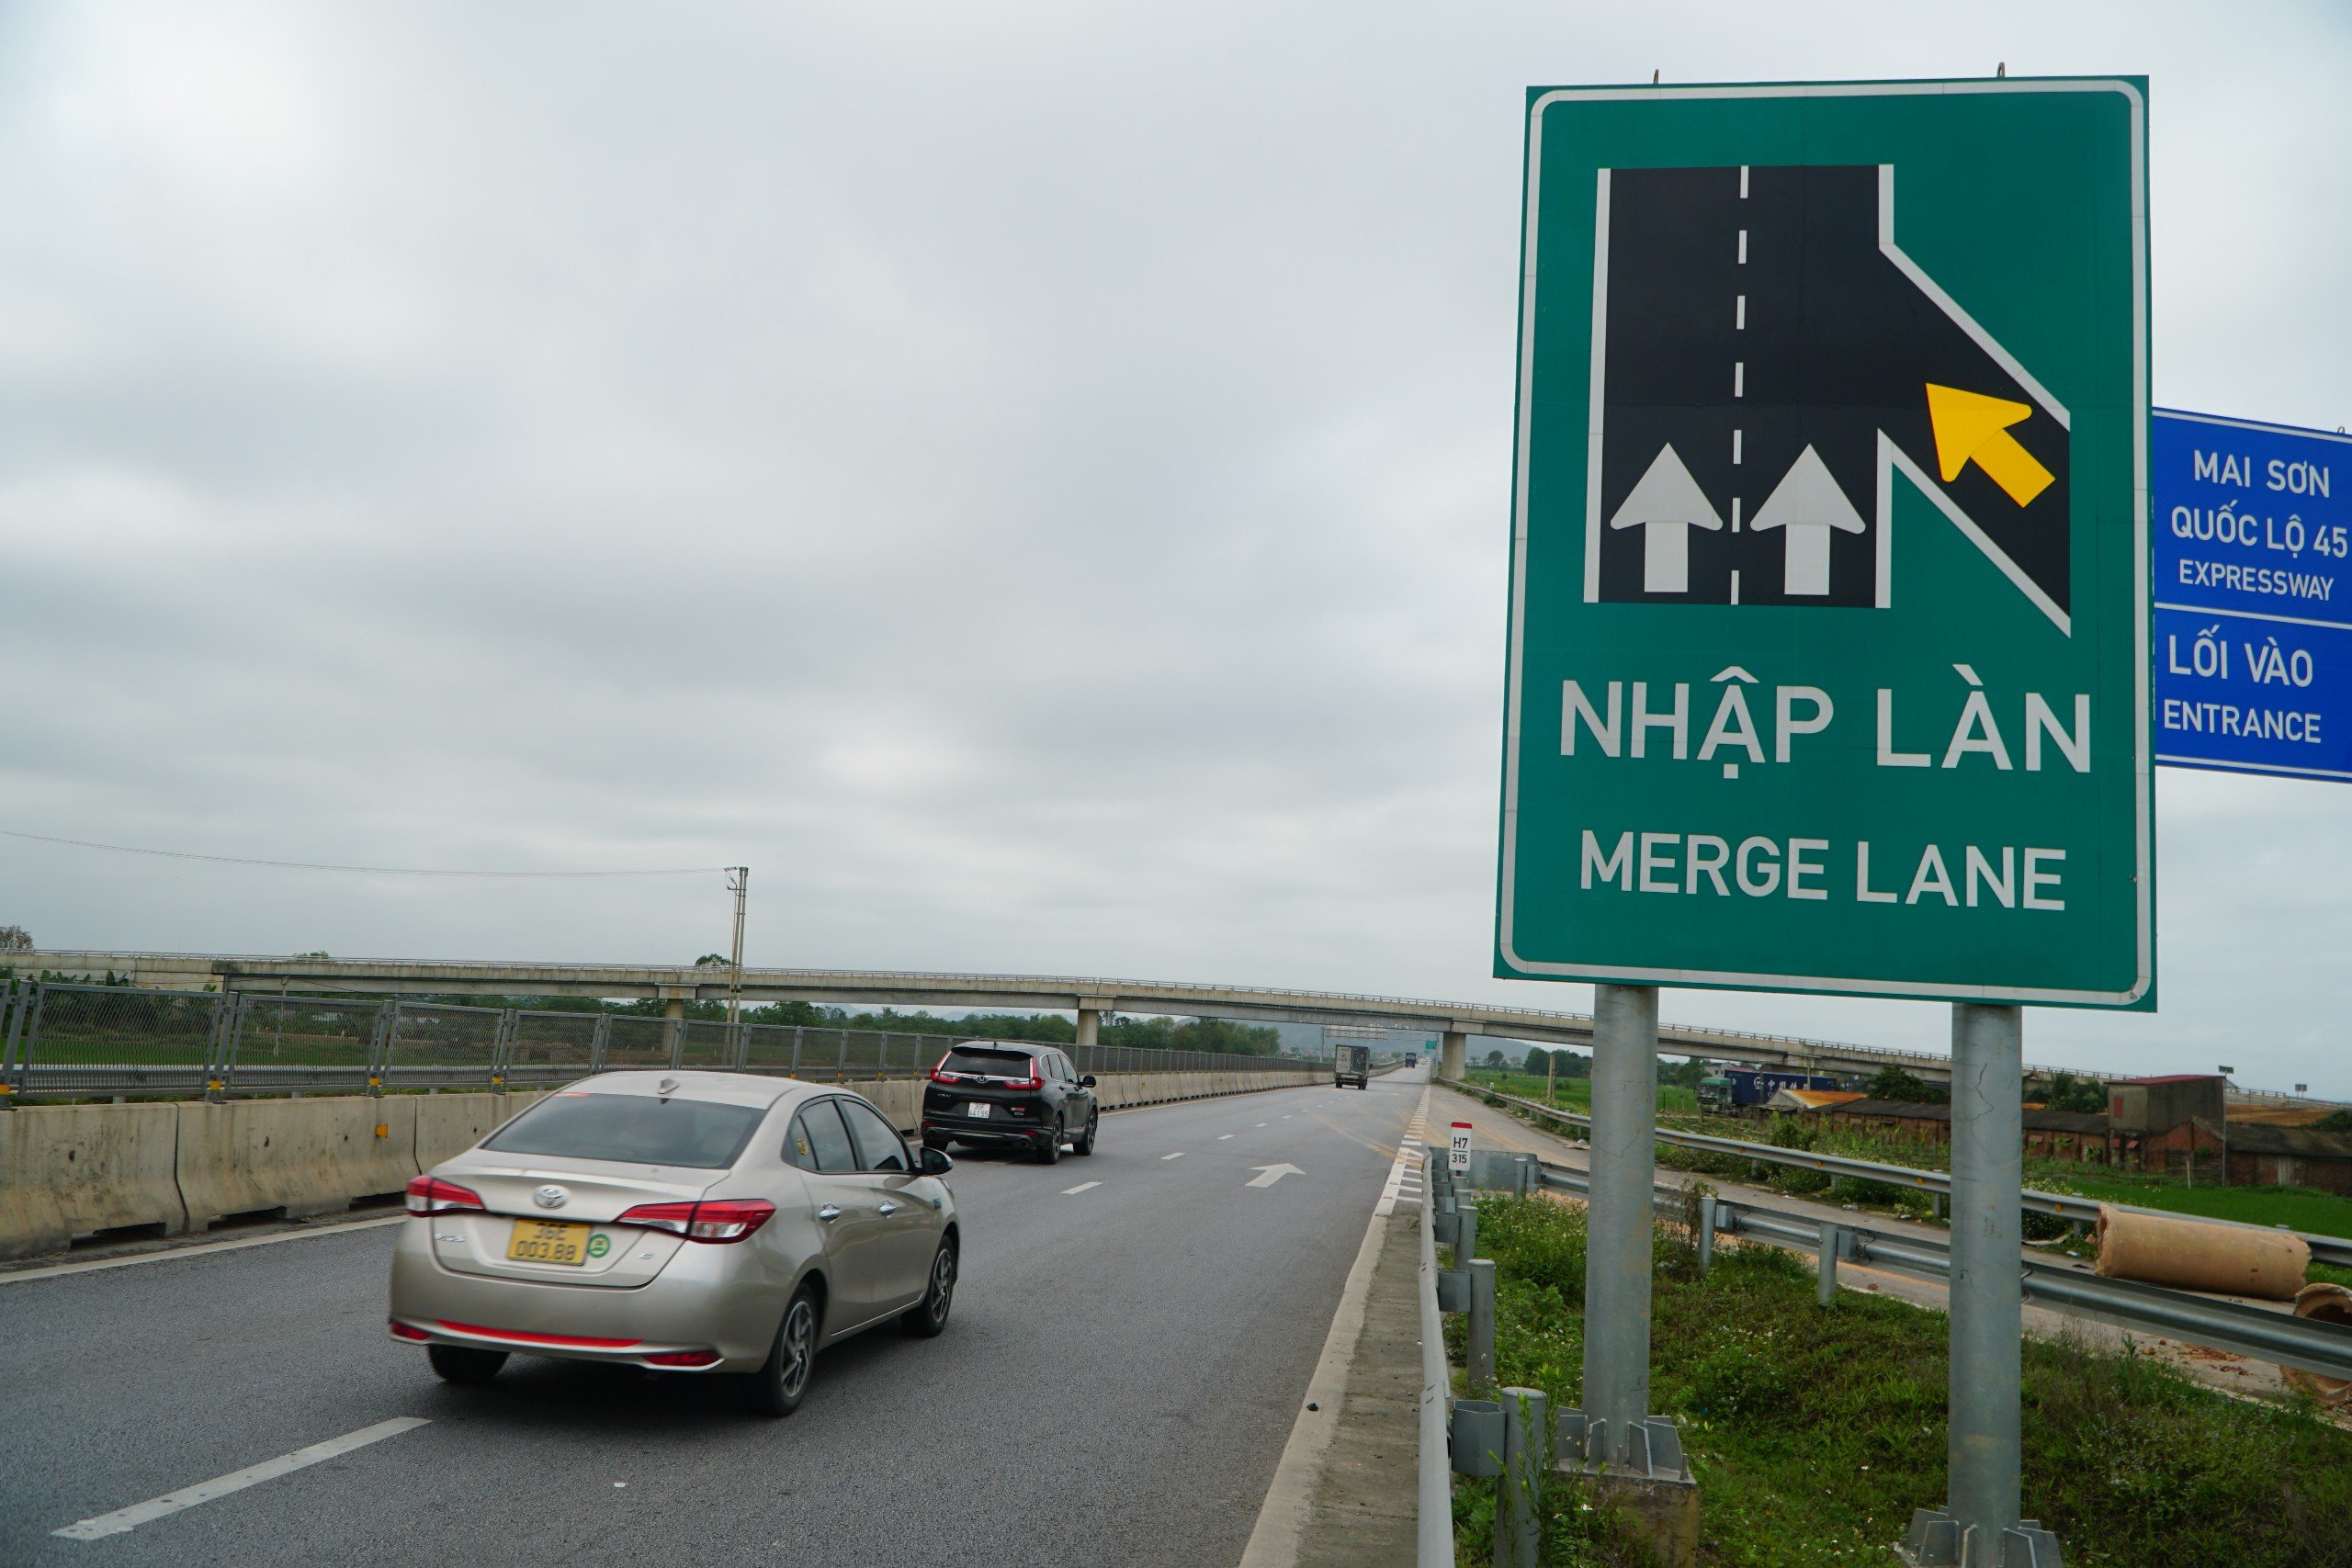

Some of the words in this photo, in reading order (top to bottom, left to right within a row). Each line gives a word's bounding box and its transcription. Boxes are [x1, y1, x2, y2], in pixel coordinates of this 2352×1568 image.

[2193, 449, 2251, 488] MAI
[2266, 459, 2330, 498] SƠN
[2171, 500, 2257, 547] QUỐC
[2267, 513, 2305, 558] LỘ
[2312, 525, 2347, 558] 45
[2179, 558, 2335, 602] EXPRESSWAY
[2168, 624, 2228, 680] LỐI
[2245, 636, 2313, 688] VÀO
[1560, 665, 1834, 779] NHẬP
[1876, 663, 2091, 773] LÀN
[2164, 698, 2322, 744] ENTRANCE
[1580, 829, 1829, 900] MERGE
[1856, 840, 2066, 911] LANE
[1452, 1153, 1467, 1164] 315
[1453, 1136, 1468, 1148] H7
